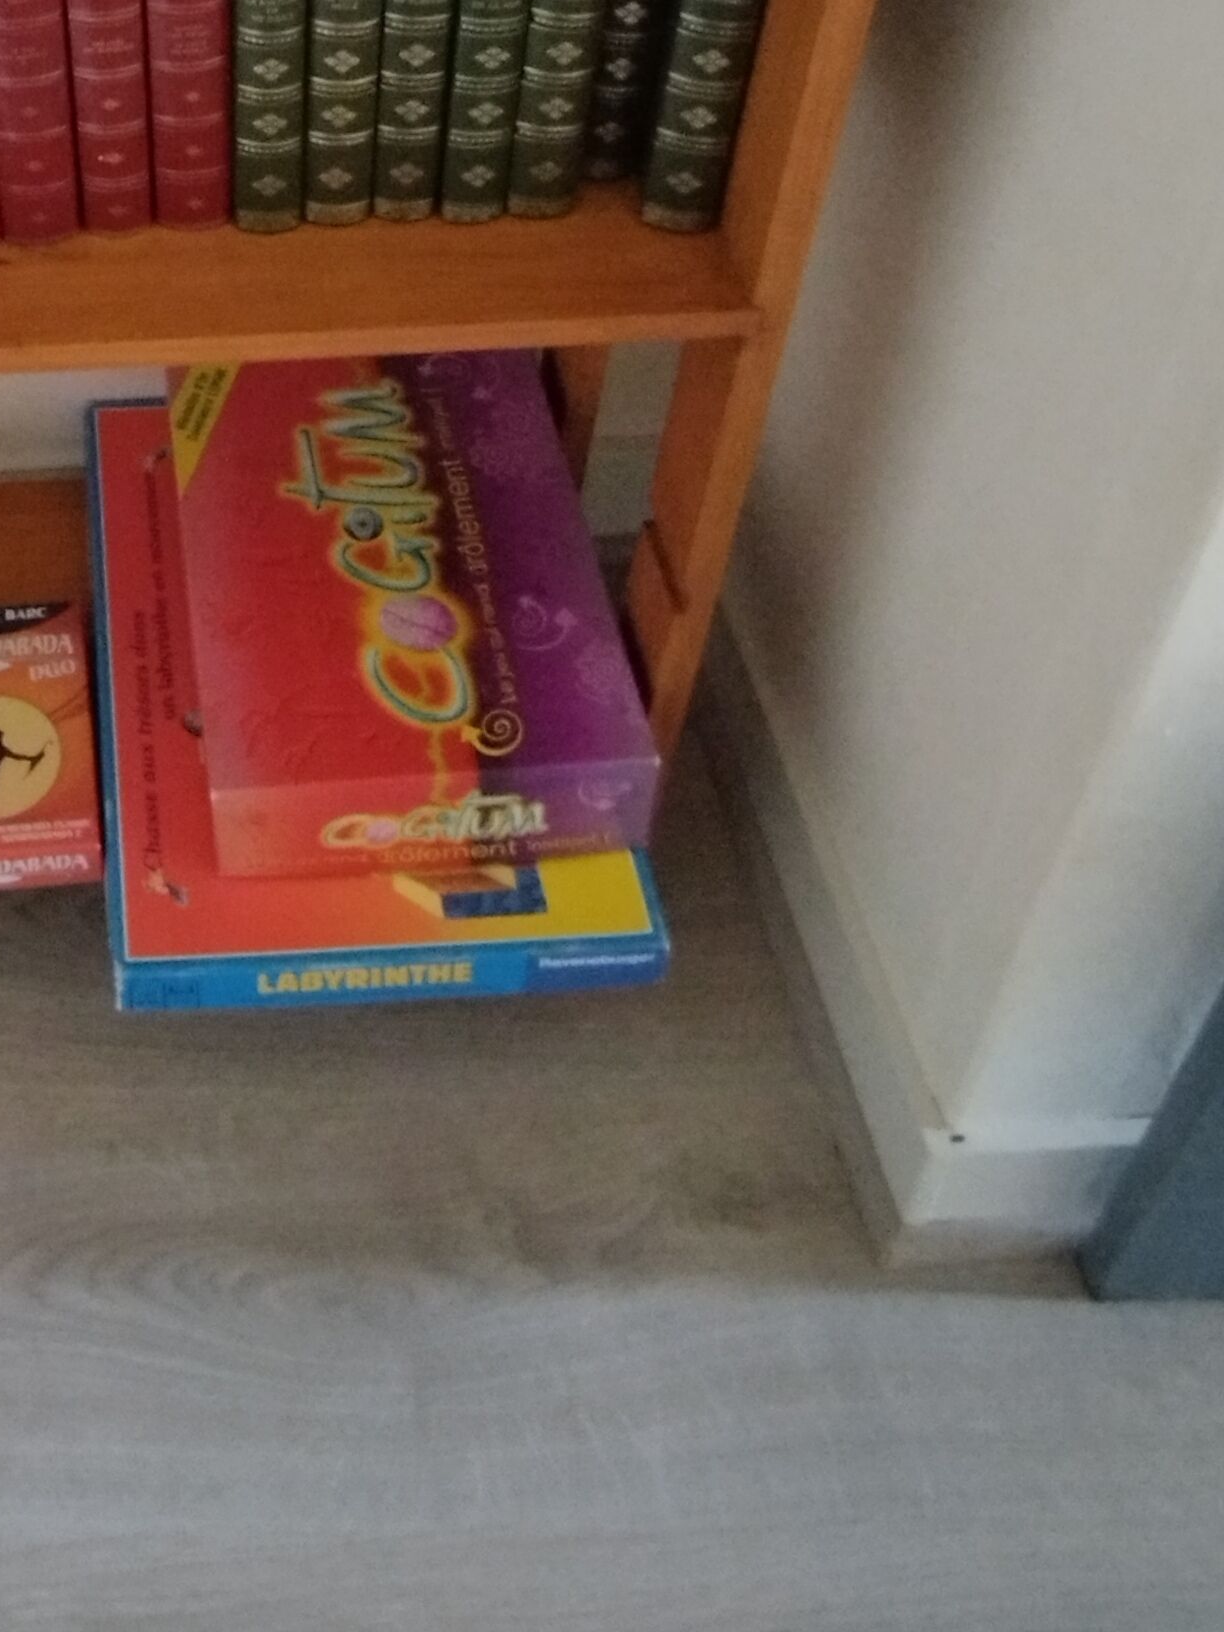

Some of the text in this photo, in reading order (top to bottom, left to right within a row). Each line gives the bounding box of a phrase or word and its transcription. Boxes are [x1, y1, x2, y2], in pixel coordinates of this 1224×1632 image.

[440, 458, 489, 574] drôlement
[4, 606, 47, 622] BARC
[29, 659, 76, 682] DUO
[129, 611, 162, 870] Chasse aux trésors dans
[256, 961, 473, 995] LABYRINTHE
